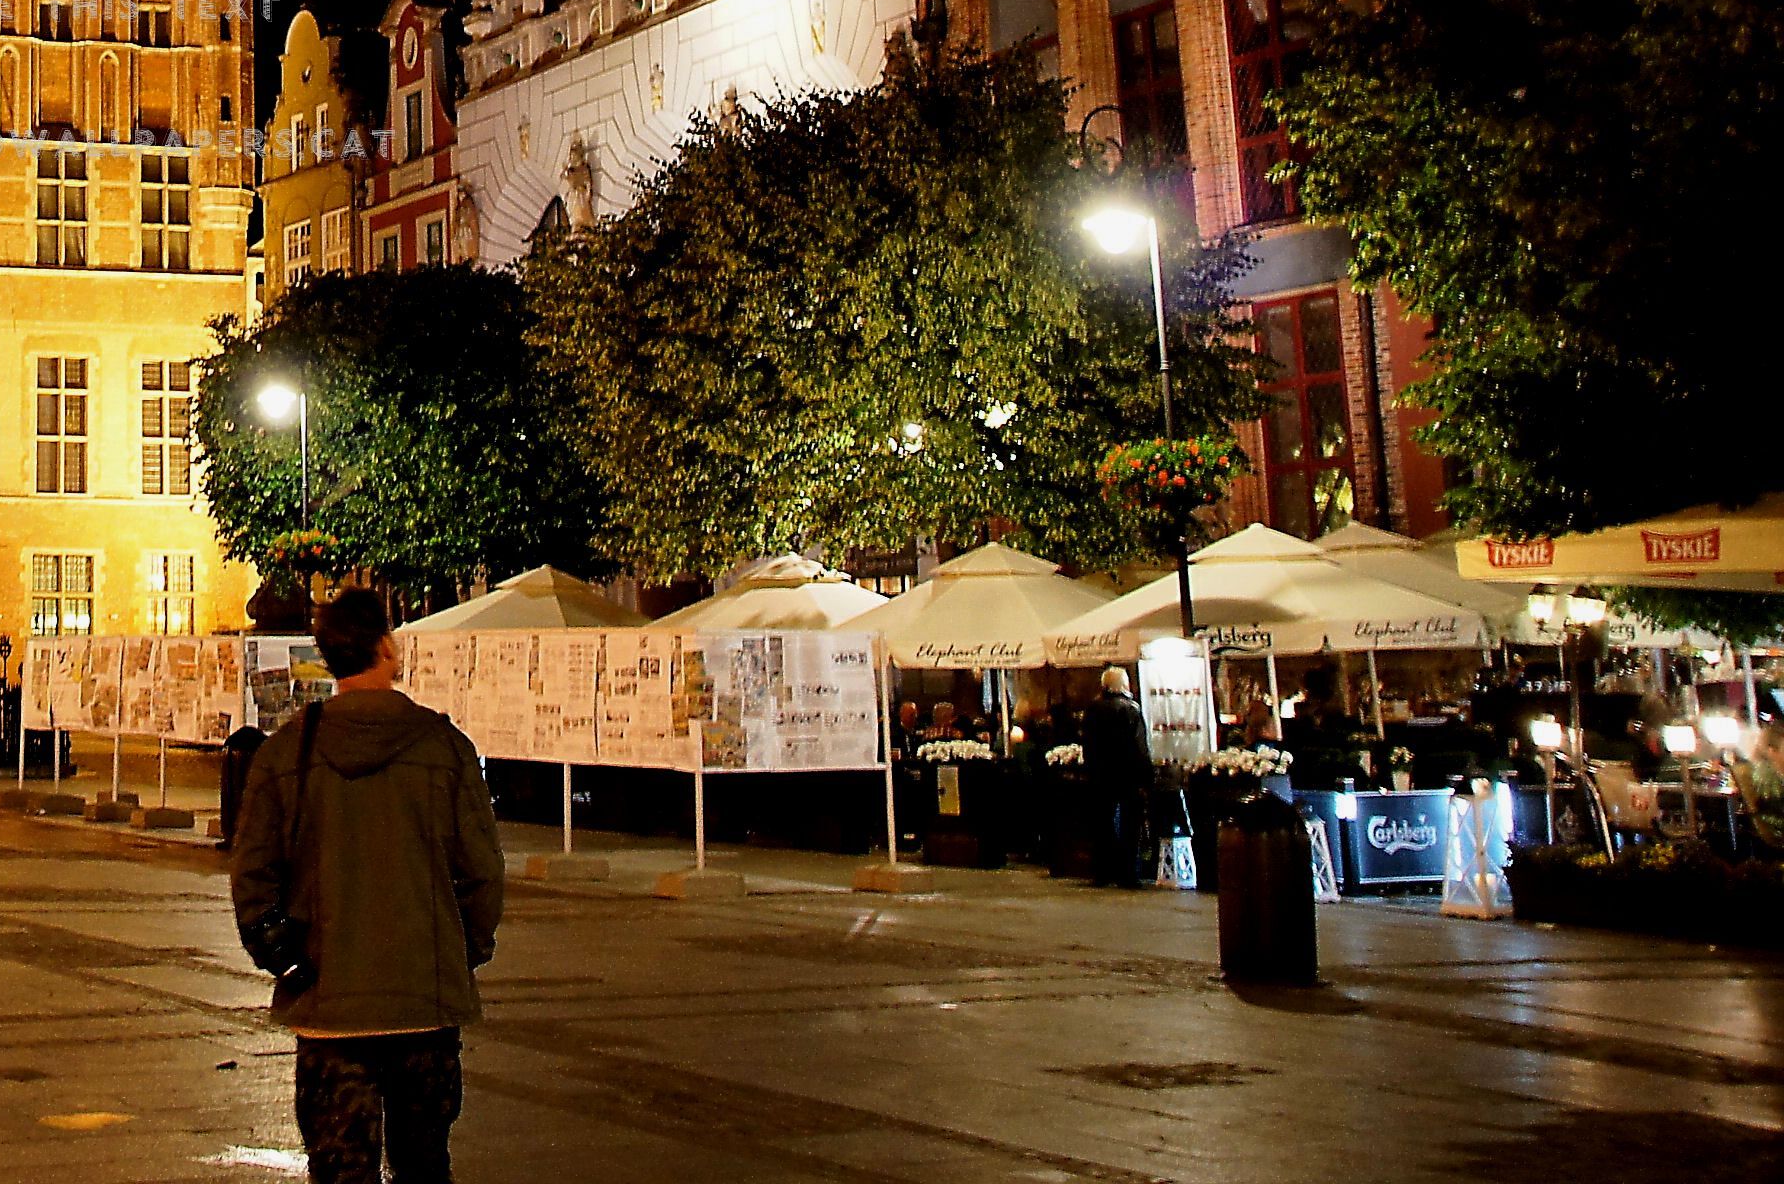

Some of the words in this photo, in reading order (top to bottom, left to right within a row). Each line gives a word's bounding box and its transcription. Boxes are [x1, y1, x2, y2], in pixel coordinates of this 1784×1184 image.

[1493, 544, 1550, 564] TYSKIE
[1644, 536, 1716, 560] TYSKIE
[1192, 622, 1274, 650] rlsberg
[1354, 618, 1419, 648] Elephant
[914, 642, 984, 668] Elephant
[989, 641, 1024, 657] Club
[1366, 814, 1437, 848] Carlsberg
